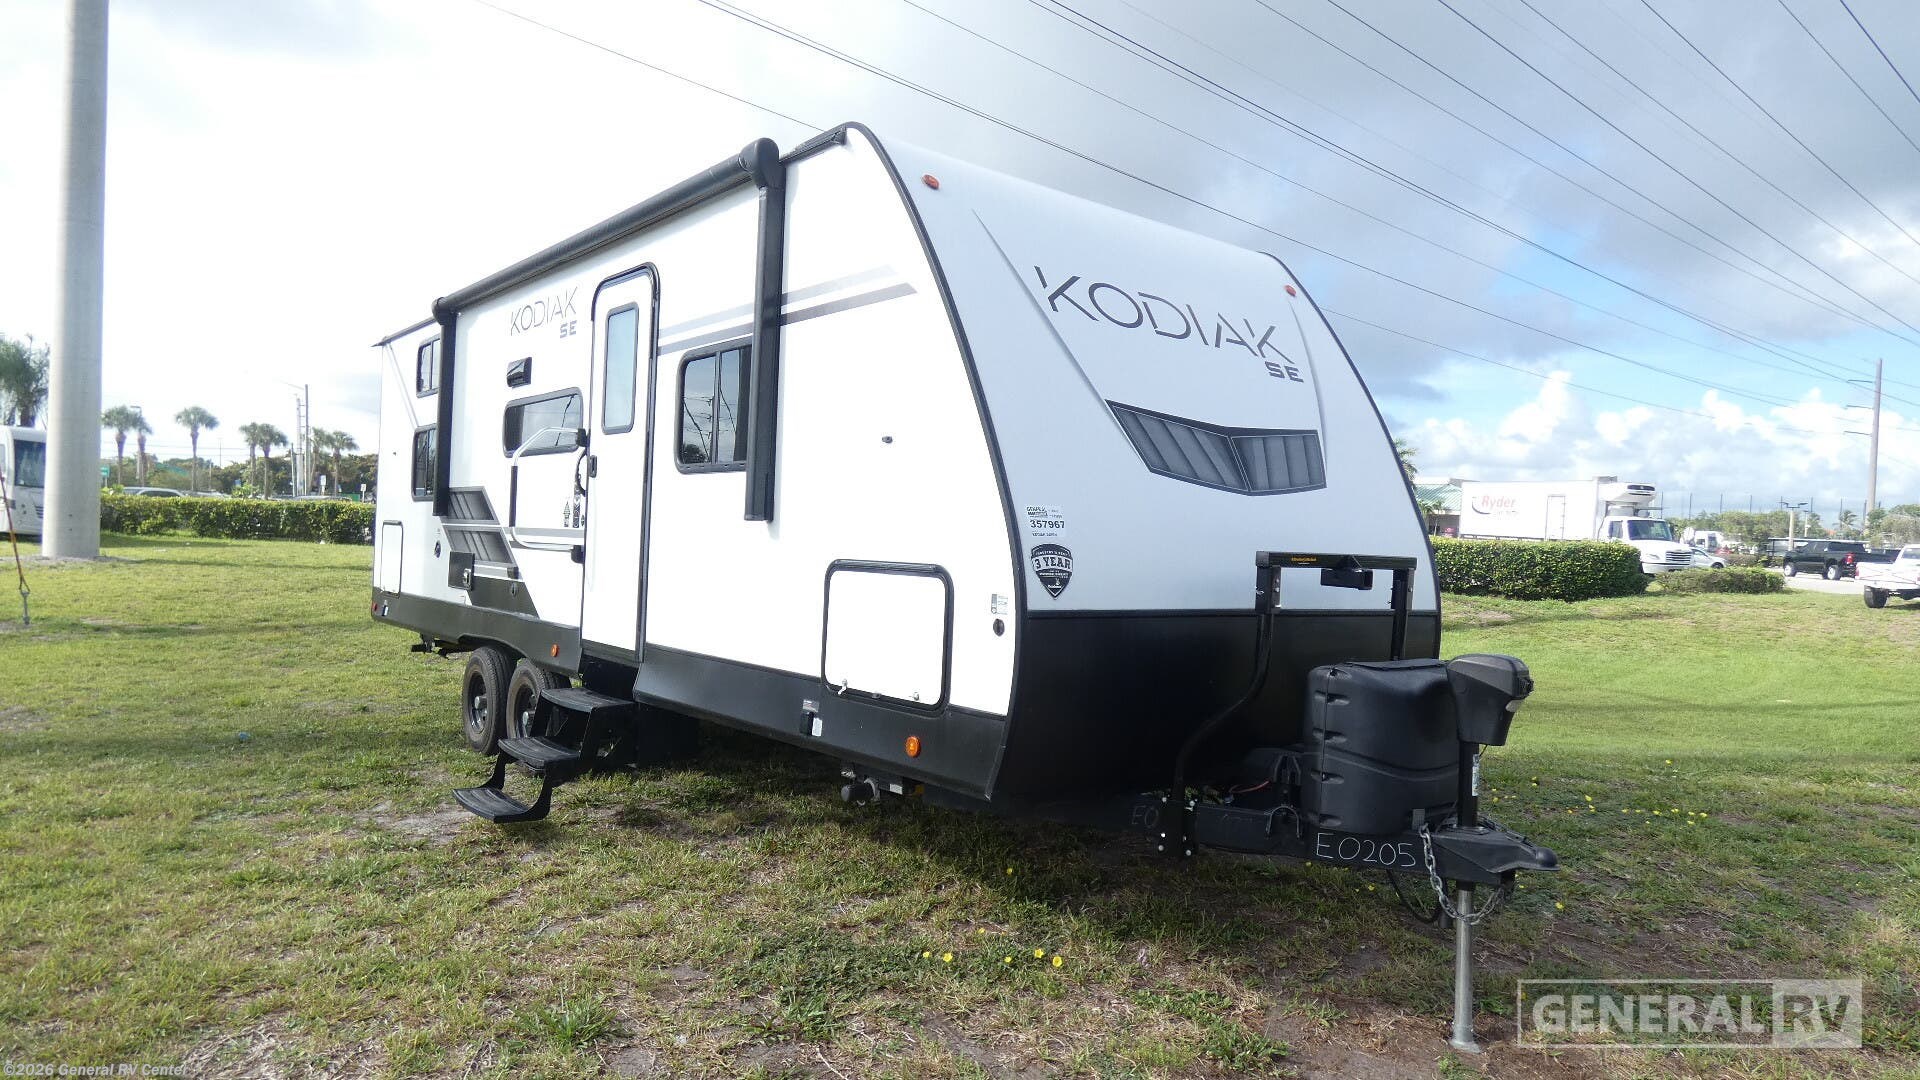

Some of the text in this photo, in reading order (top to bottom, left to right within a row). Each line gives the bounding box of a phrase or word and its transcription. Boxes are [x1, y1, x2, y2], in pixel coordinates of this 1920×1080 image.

[510, 286, 578, 336] KODIAK
[1034, 265, 1295, 364] KODIAK
[560, 320, 578, 339] SE
[1264, 361, 1304, 383] SE
[1481, 495, 1516, 510] Ryder
[1029, 519, 1065, 529] 357967
[1034, 556, 1071, 570] 3 YEAR
